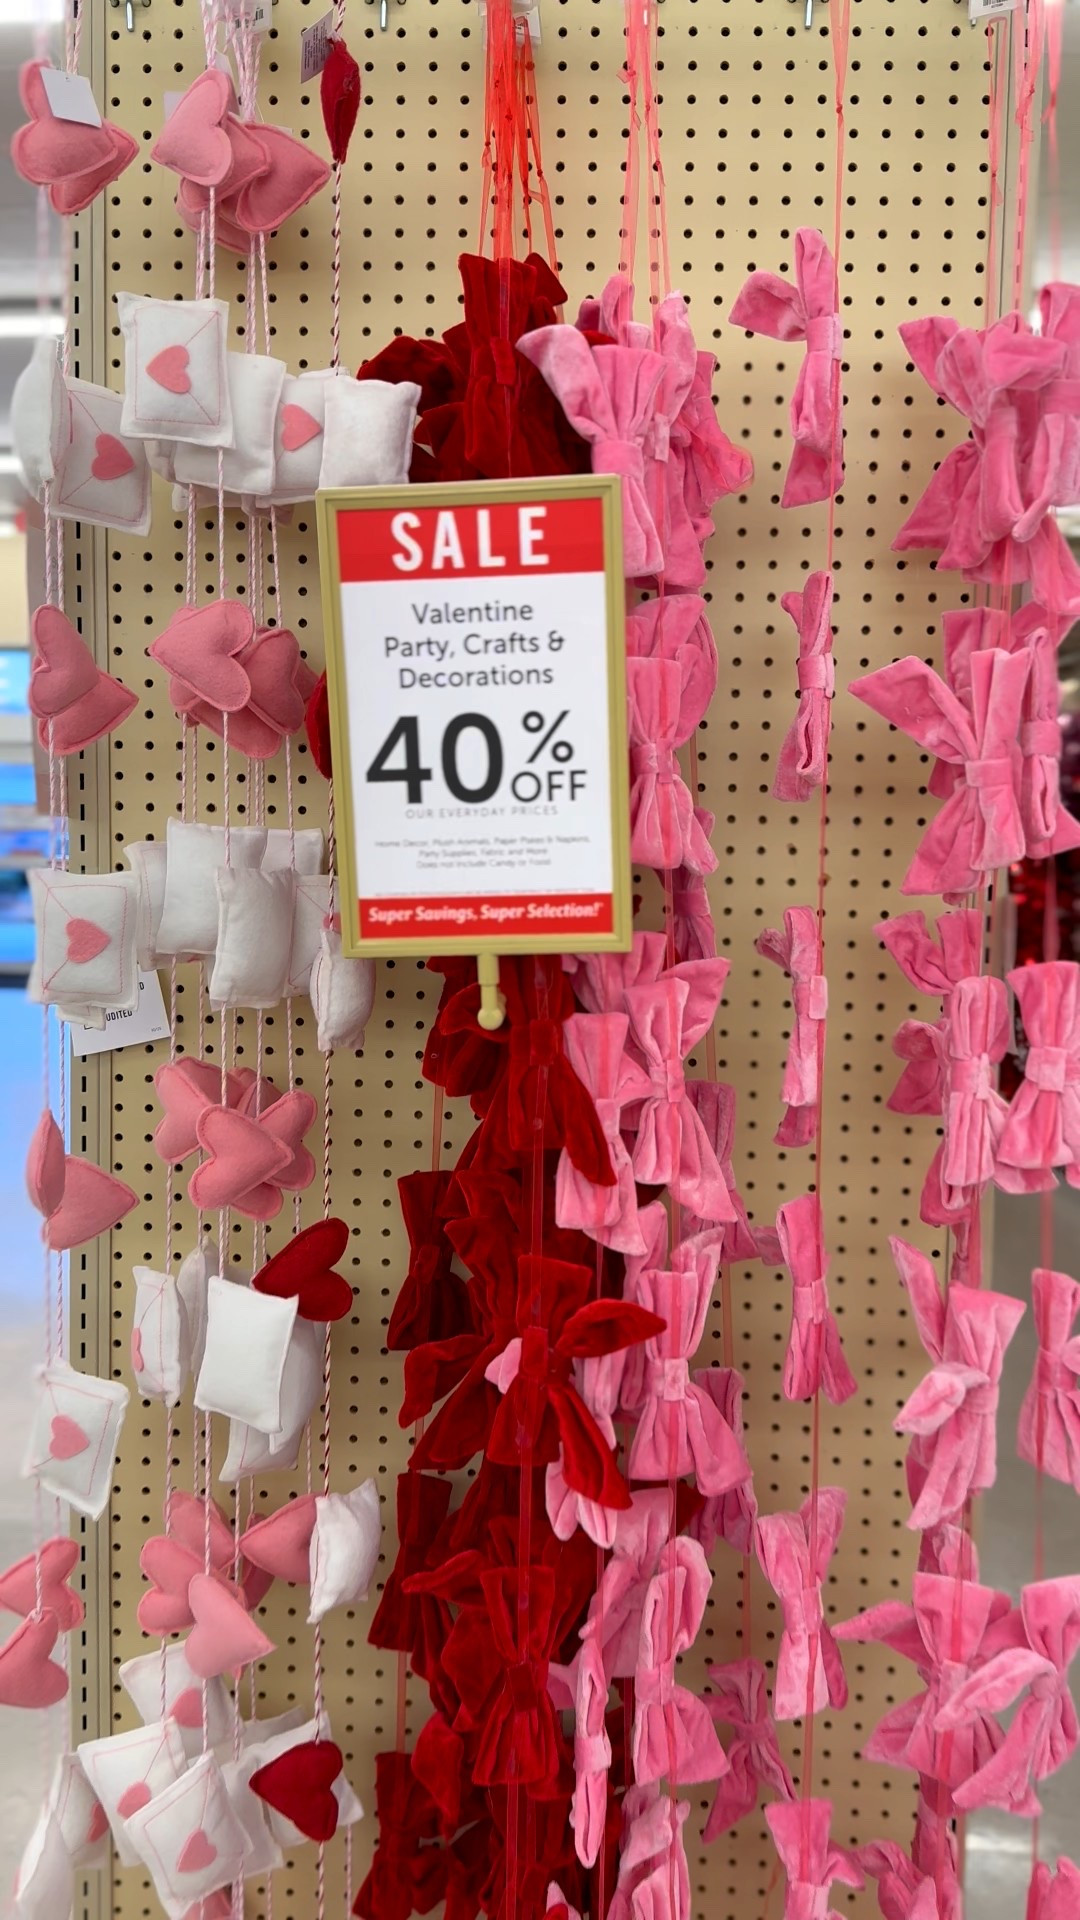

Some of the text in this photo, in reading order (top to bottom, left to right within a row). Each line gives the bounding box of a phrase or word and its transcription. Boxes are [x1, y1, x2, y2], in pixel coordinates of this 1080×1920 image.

[391, 506, 550, 571] SALE
[412, 600, 533, 625] Valentine
[384, 631, 565, 661] Party, Crafts &
[399, 666, 554, 689] Decorations
[511, 770, 588, 802] OFF
[405, 806, 559, 819] OUR EVERYDAY PRICES
[369, 902, 600, 925] Super Savings, Super Selection!
[105, 1009, 133, 1022] UDITED
